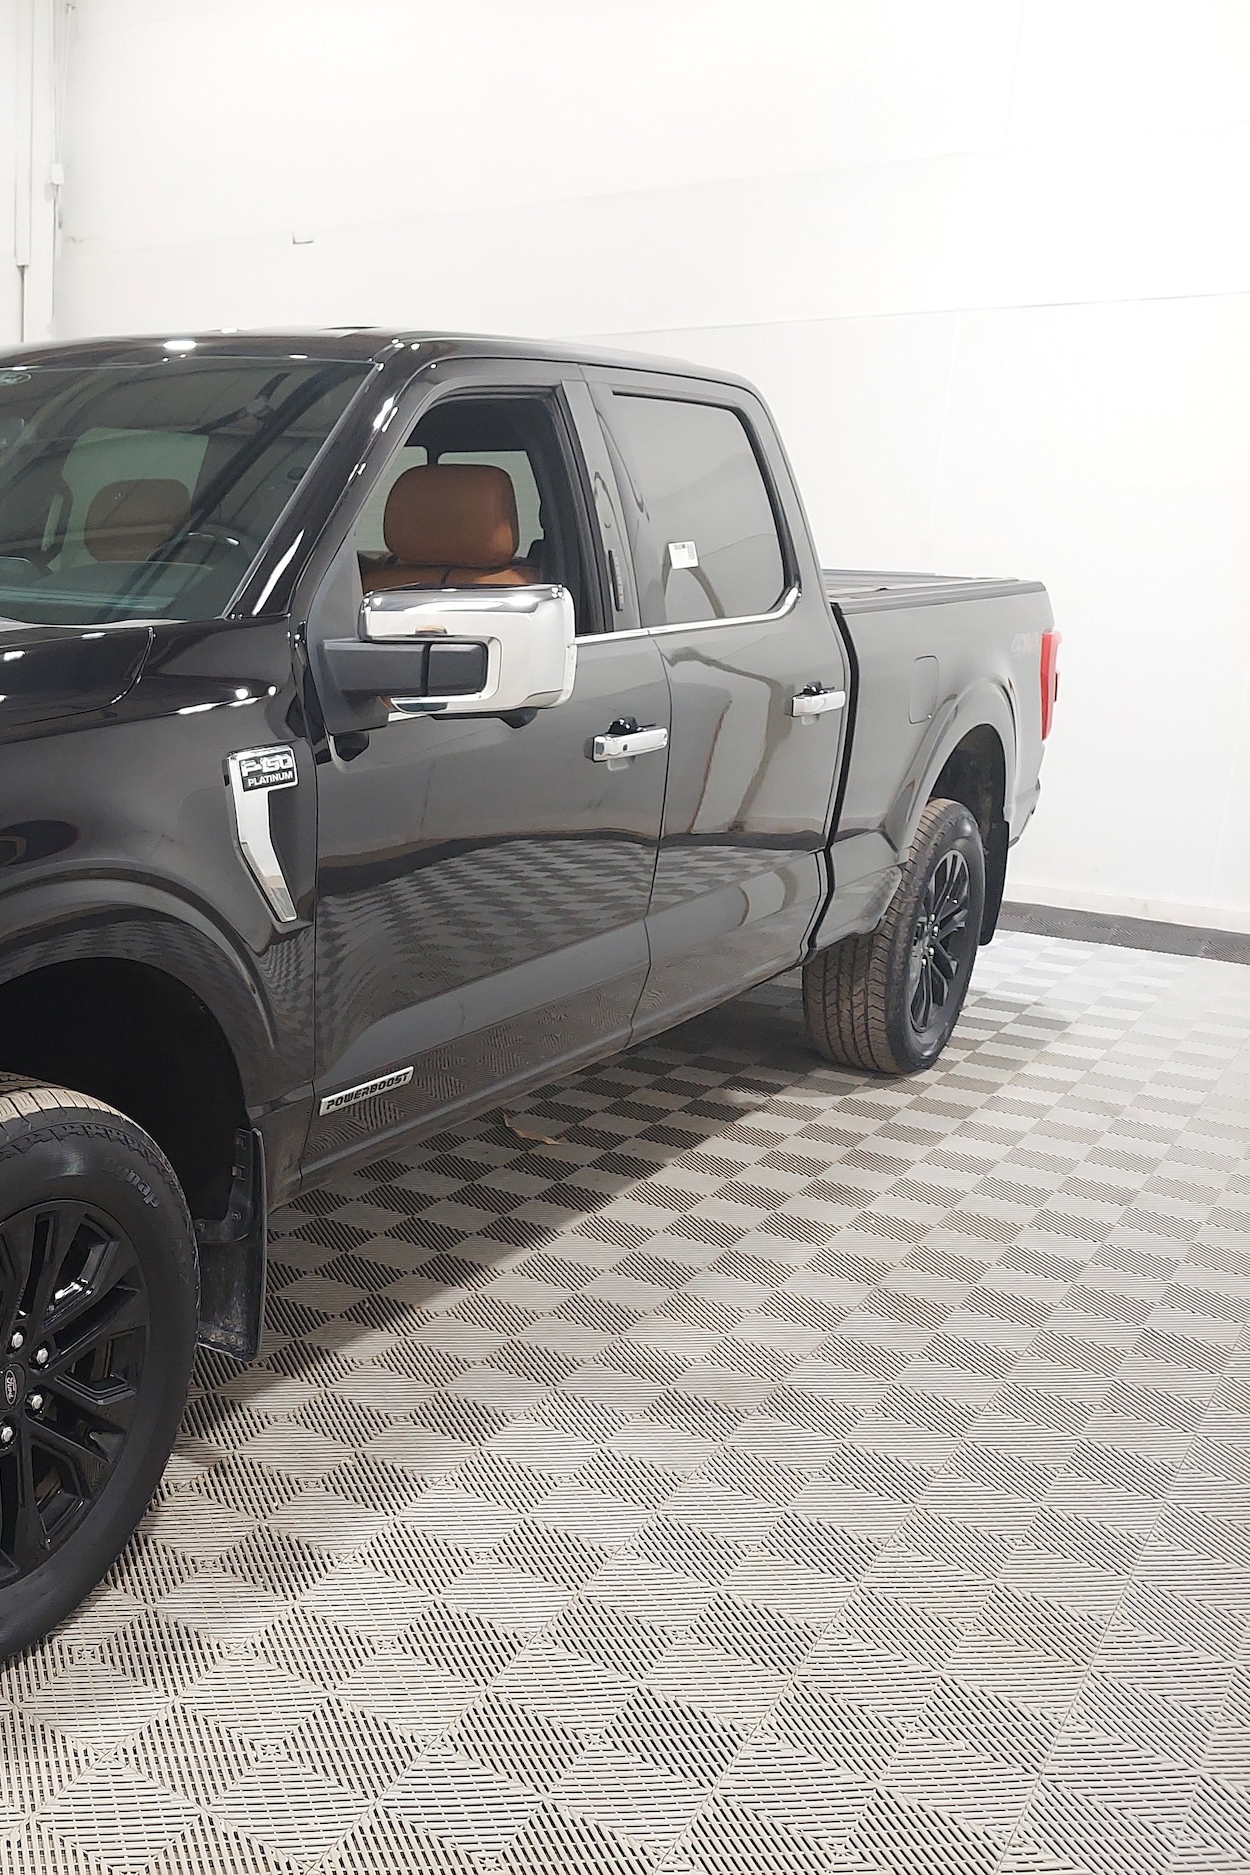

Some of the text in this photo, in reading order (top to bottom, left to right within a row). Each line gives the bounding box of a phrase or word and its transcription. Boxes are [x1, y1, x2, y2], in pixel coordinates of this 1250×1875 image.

[241, 753, 293, 777] F-150
[247, 771, 293, 787] PLATINUM
[325, 1071, 410, 1110] POWERBOOST
